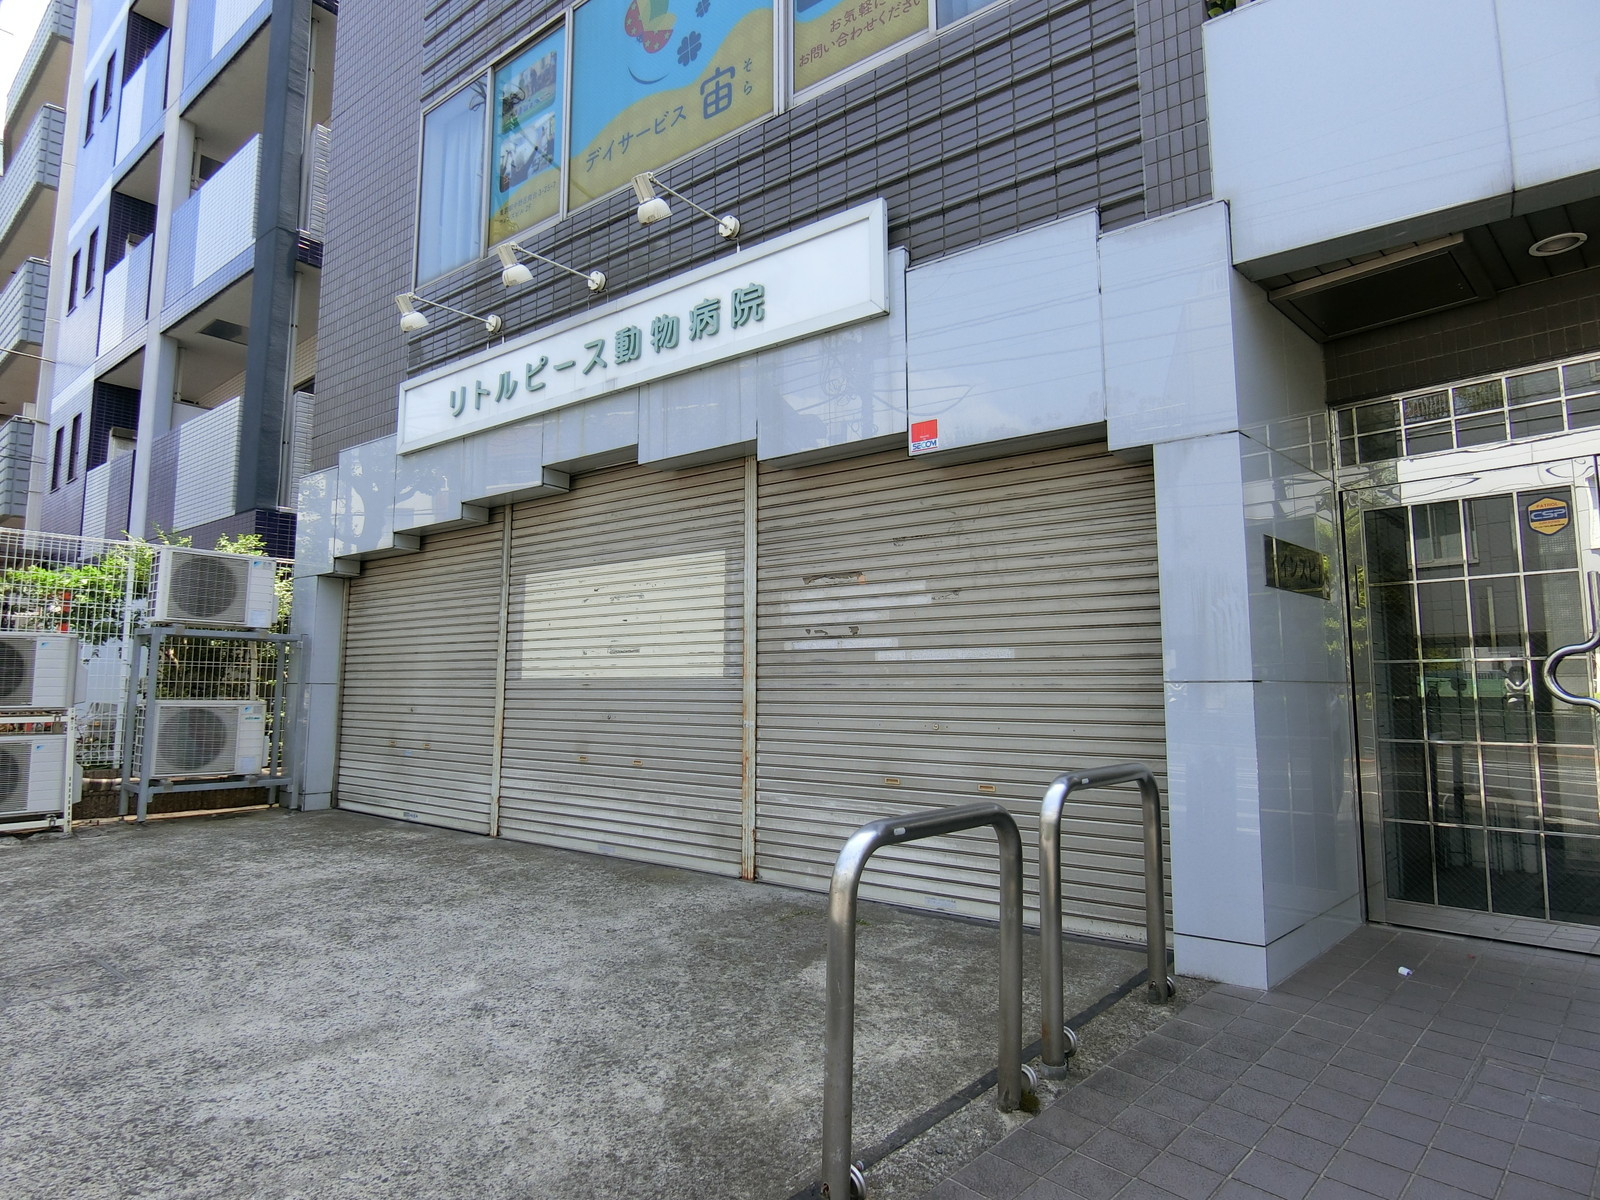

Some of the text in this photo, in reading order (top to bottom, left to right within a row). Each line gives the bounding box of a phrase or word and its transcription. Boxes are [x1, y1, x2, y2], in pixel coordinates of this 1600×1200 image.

[743, 57, 753, 96] そら
[586, 66, 736, 172] デイサービス 宙
[449, 282, 766, 418] リトルピース動物病院
[912, 439, 937, 451] SECOM
[1530, 508, 1566, 520] CSP
